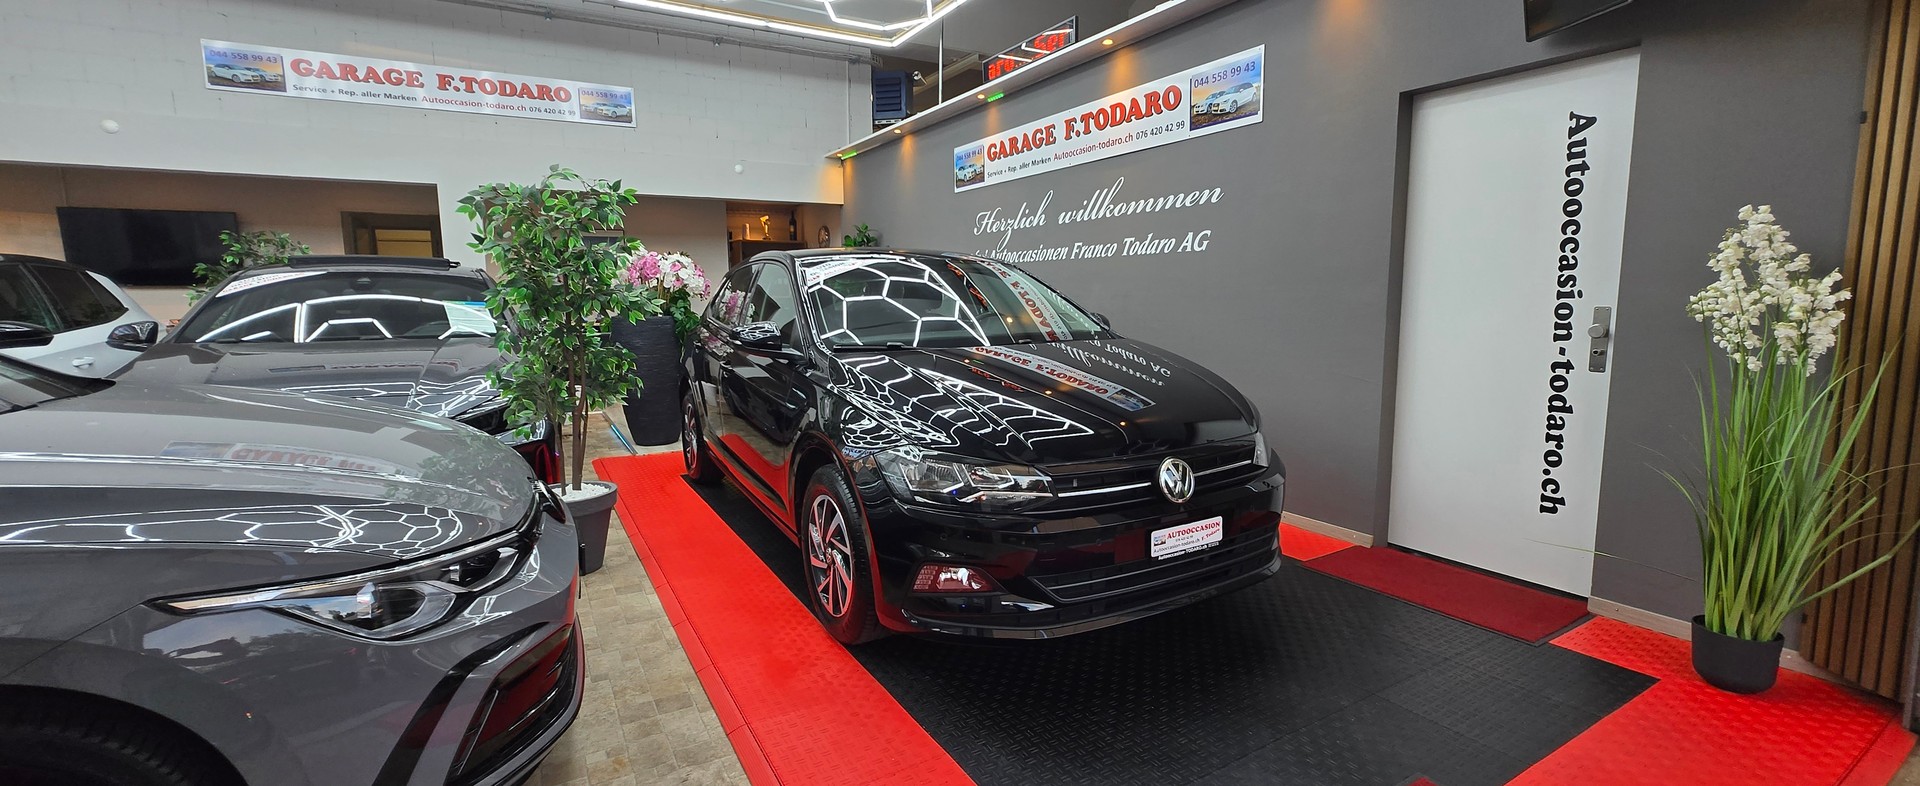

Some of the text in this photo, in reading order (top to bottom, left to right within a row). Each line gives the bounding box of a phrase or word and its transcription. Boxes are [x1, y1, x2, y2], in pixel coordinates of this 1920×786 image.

[210, 50, 278, 64] 044 558 99 43
[290, 58, 572, 103] GARAGE F.TODARO
[1194, 61, 1256, 88] 044 558 99 43
[292, 84, 328, 94] Service
[338, 88, 359, 99] Rep.
[361, 90, 382, 98] aller
[384, 92, 418, 102] Marken
[421, 95, 527, 112] Autooccasion-todaro.ch
[557, 108, 566, 116] 42
[596, 90, 608, 98] 558
[986, 85, 1182, 162] GARAGE F.TODARO
[987, 168, 1003, 178] Service
[1008, 165, 1018, 174] Rep.
[1019, 161, 1031, 170] aller
[1031, 157, 1052, 168] Marken
[1053, 133, 1134, 162] Autooccasion-todaro.ch
[1136, 130, 1148, 140] 076
[1150, 126, 1163, 136] 420
[1164, 123, 1174, 132] 42
[1176, 120, 1186, 130] 99
[974, 176, 1225, 252] Herzlich willkommen
[1070, 242, 1118, 260] Franco
[1121, 232, 1177, 256] Todaro
[1178, 230, 1212, 253] AG
[1539, 110, 1598, 516] Autooccasion-todaro.ch
[1166, 522, 1221, 540] AUTOOCCASION
